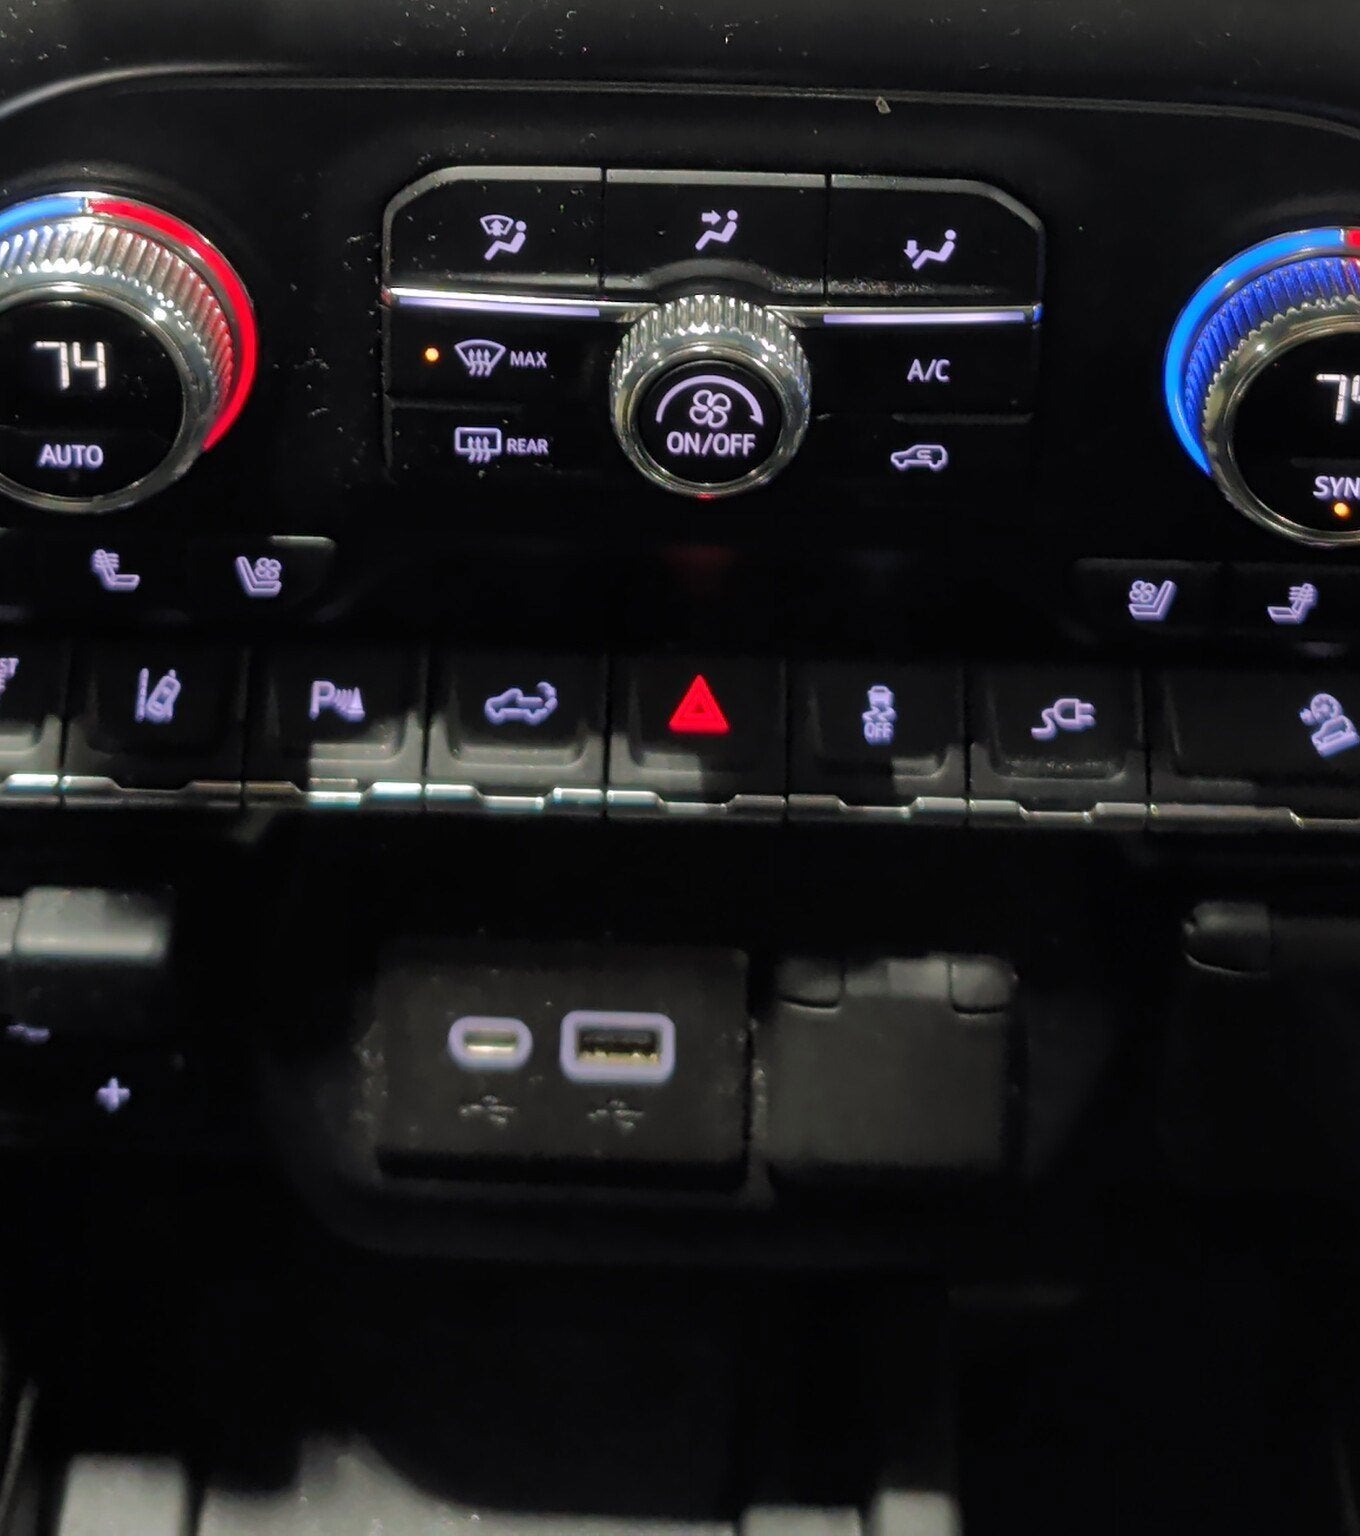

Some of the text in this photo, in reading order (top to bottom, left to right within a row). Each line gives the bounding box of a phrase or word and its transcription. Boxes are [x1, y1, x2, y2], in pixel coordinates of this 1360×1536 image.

[34, 340, 107, 390] 74
[509, 350, 547, 369] MAX
[906, 358, 950, 383] A/C
[38, 443, 104, 469] AUTO
[506, 437, 549, 455] REAR
[666, 430, 756, 457] ON/OFF
[863, 722, 894, 744] OFF
